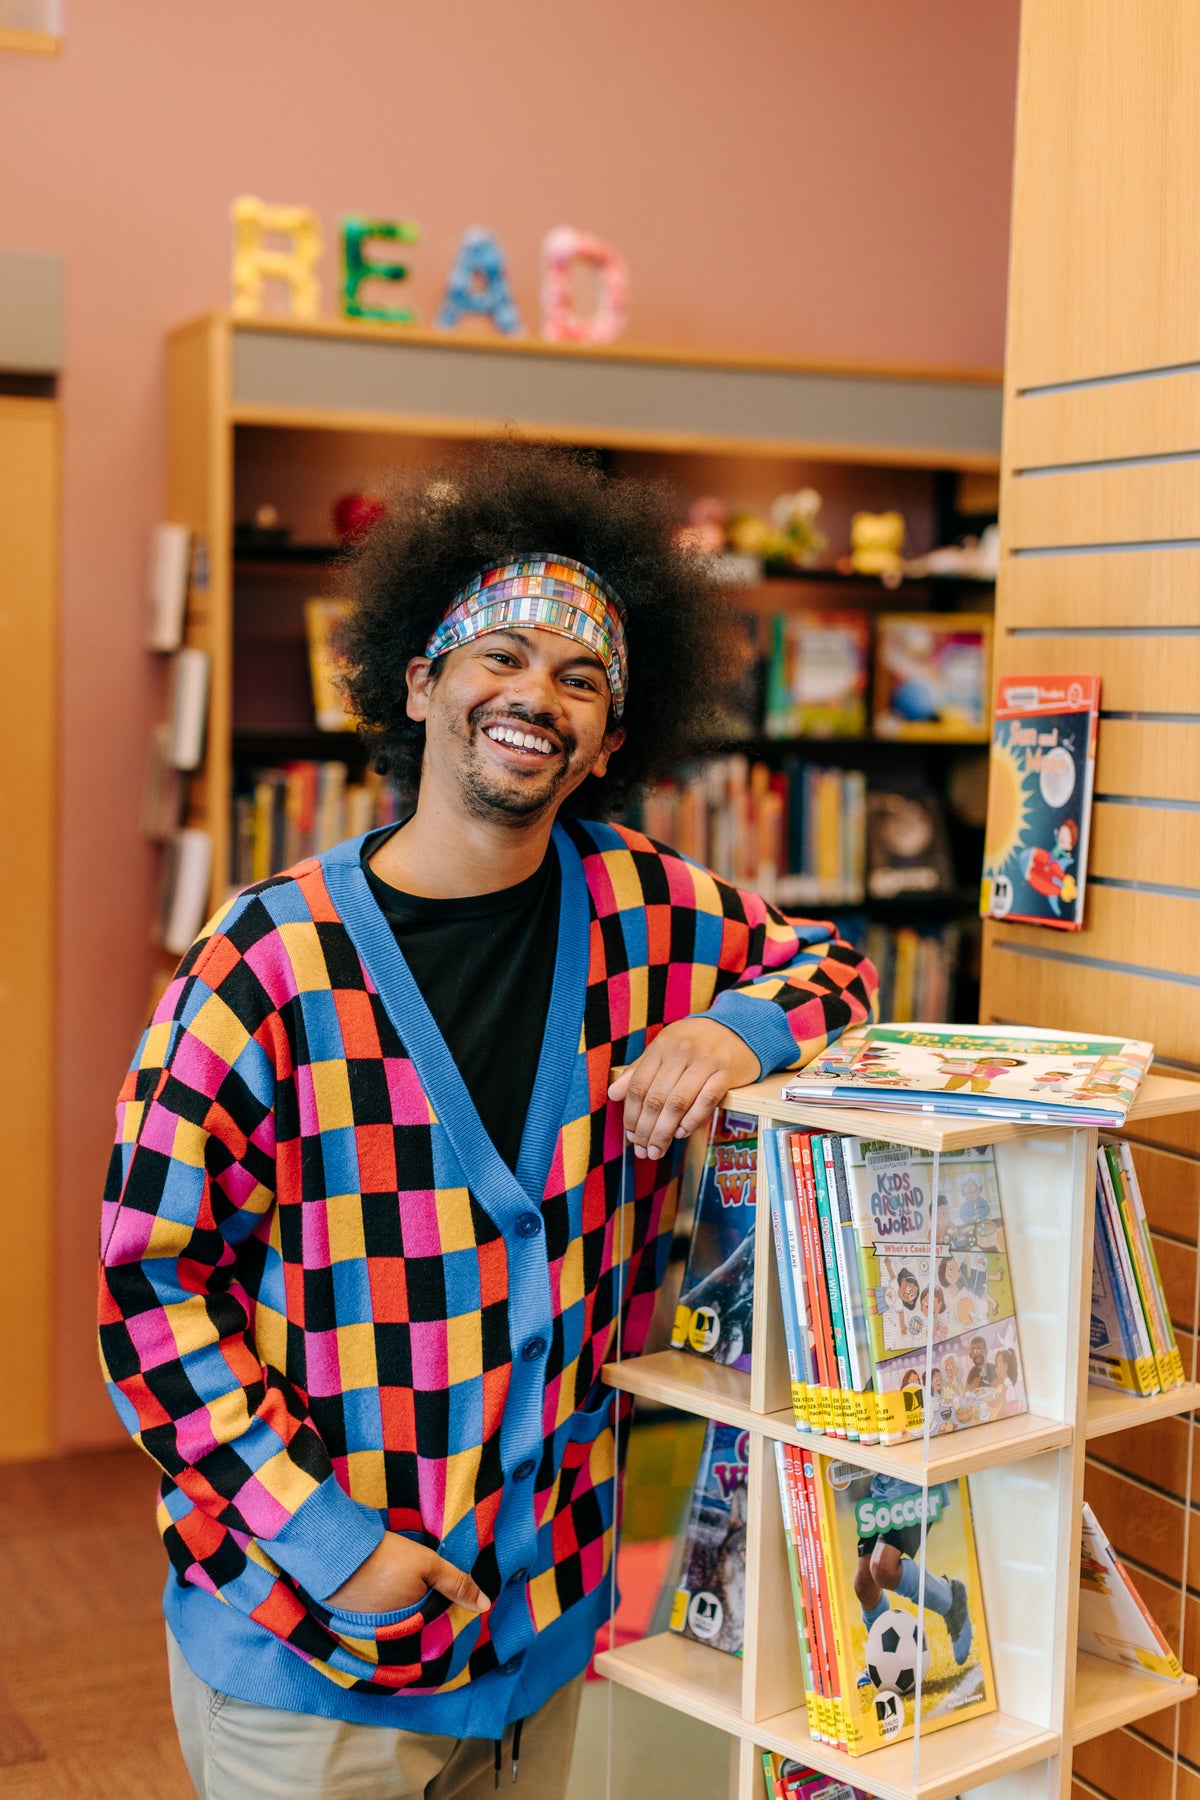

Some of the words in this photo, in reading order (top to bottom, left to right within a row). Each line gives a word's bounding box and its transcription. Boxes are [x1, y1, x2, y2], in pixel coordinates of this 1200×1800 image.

[232, 195, 628, 343] READ
[950, 1036, 985, 1045] So
[877, 1172, 910, 1196] KIDS
[871, 1187, 923, 1217] AROUND
[874, 1211, 923, 1236] WORLD
[789, 1244, 797, 1268] PLANE
[814, 1245, 822, 1275] MACHINES
[885, 1245, 908, 1253] What's
[828, 1279, 837, 1301] WHY
[859, 1495, 939, 1533] Soccer
[814, 1540, 822, 1567] FOOTBALL
[879, 1725, 899, 1737] LIBRARY
